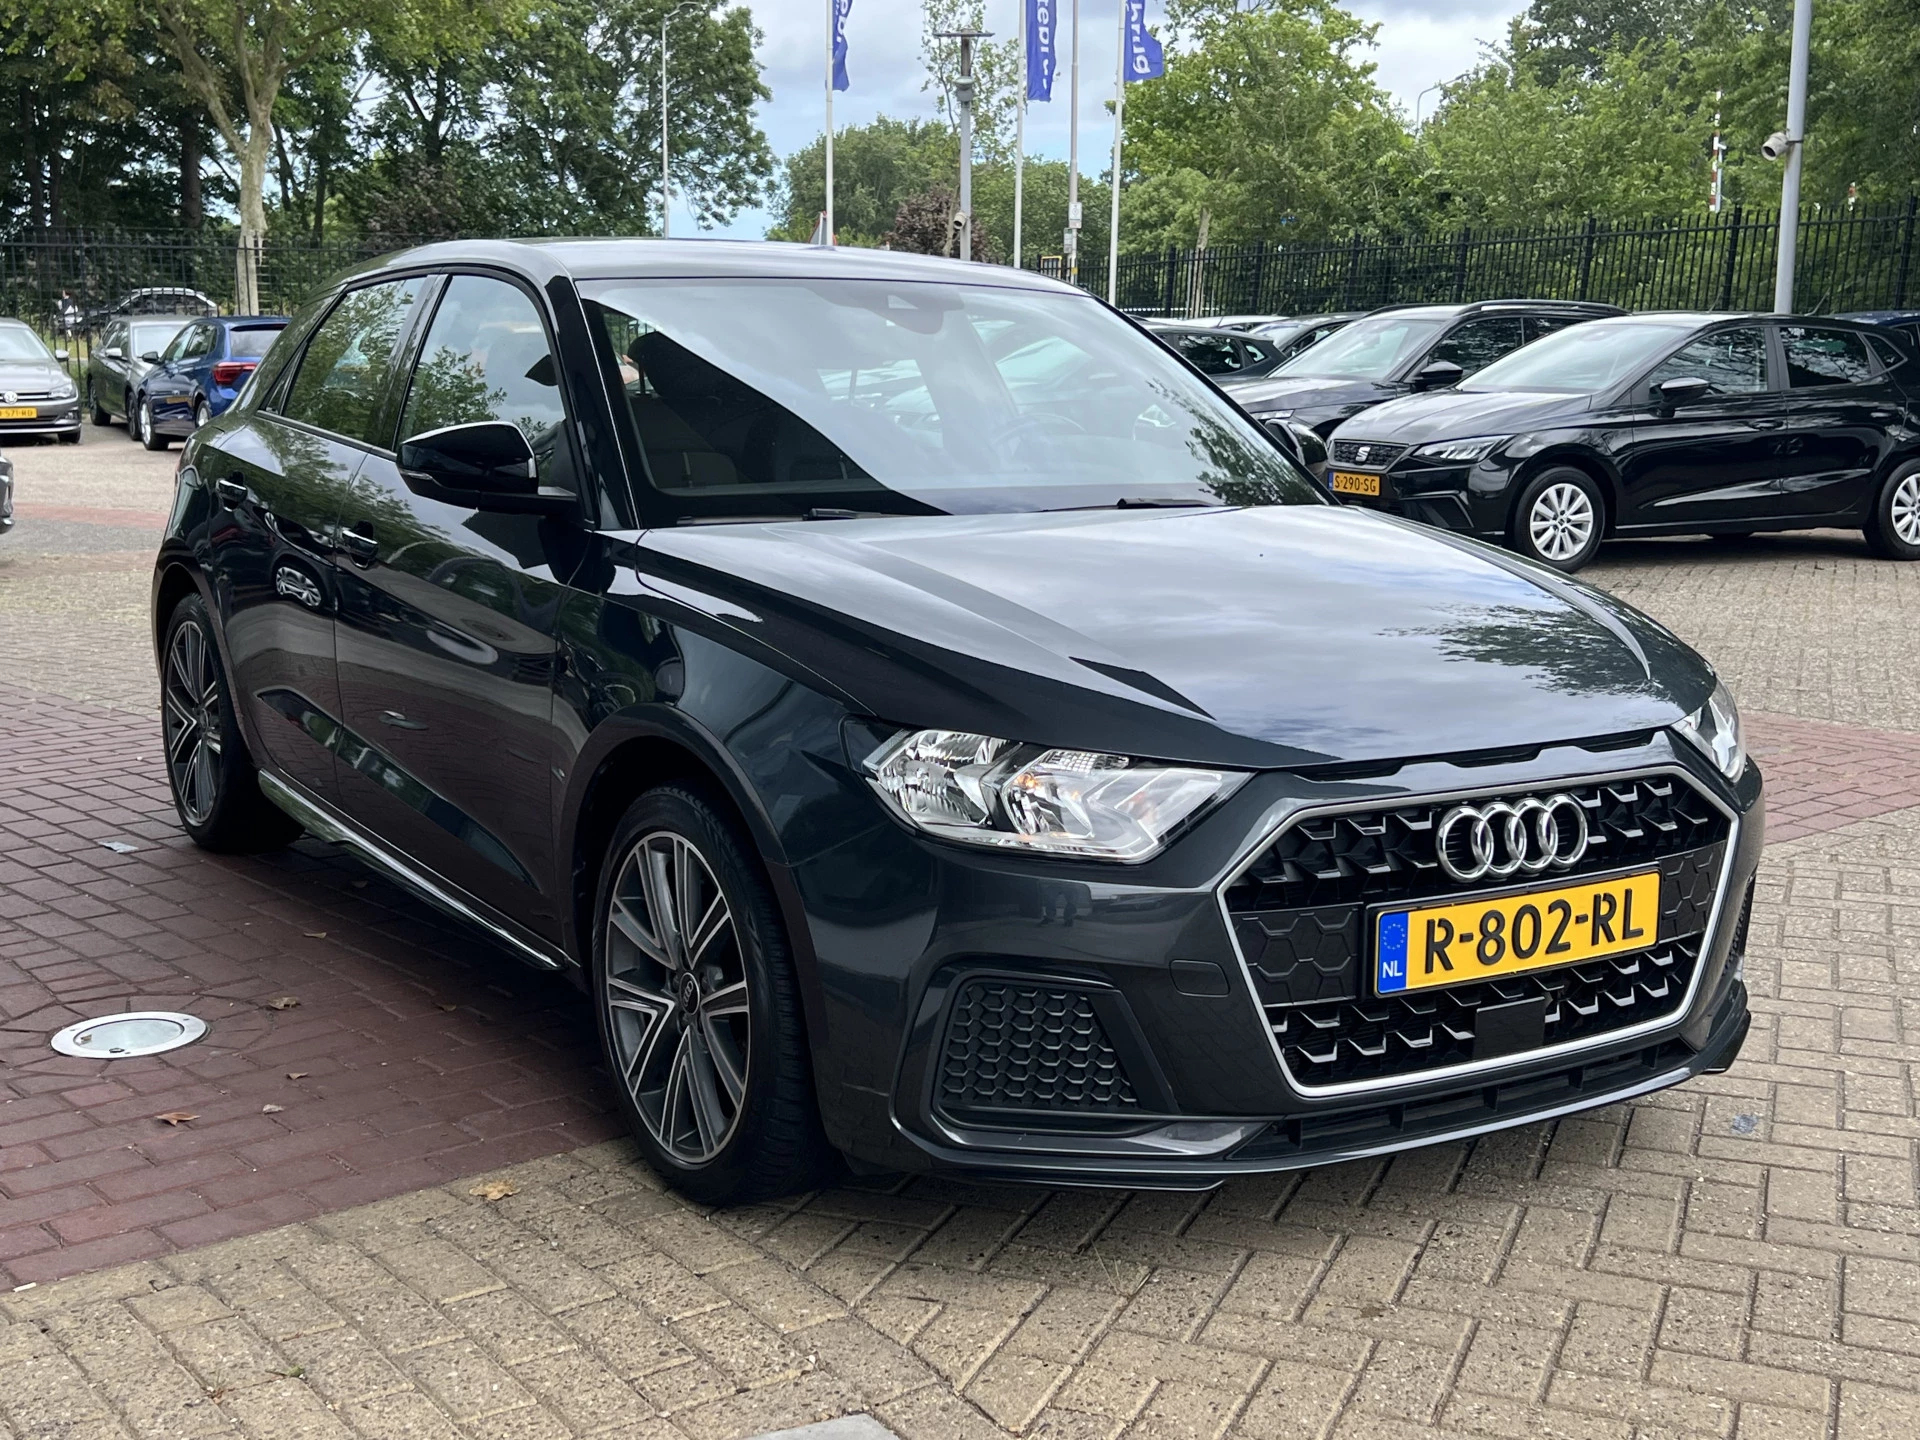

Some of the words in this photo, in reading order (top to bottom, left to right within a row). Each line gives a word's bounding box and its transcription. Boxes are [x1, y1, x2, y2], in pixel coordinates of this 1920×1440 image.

[1334, 475, 1377, 493] S-290-SG
[1425, 888, 1644, 974] R-802-RL
[1382, 960, 1403, 979] NL
